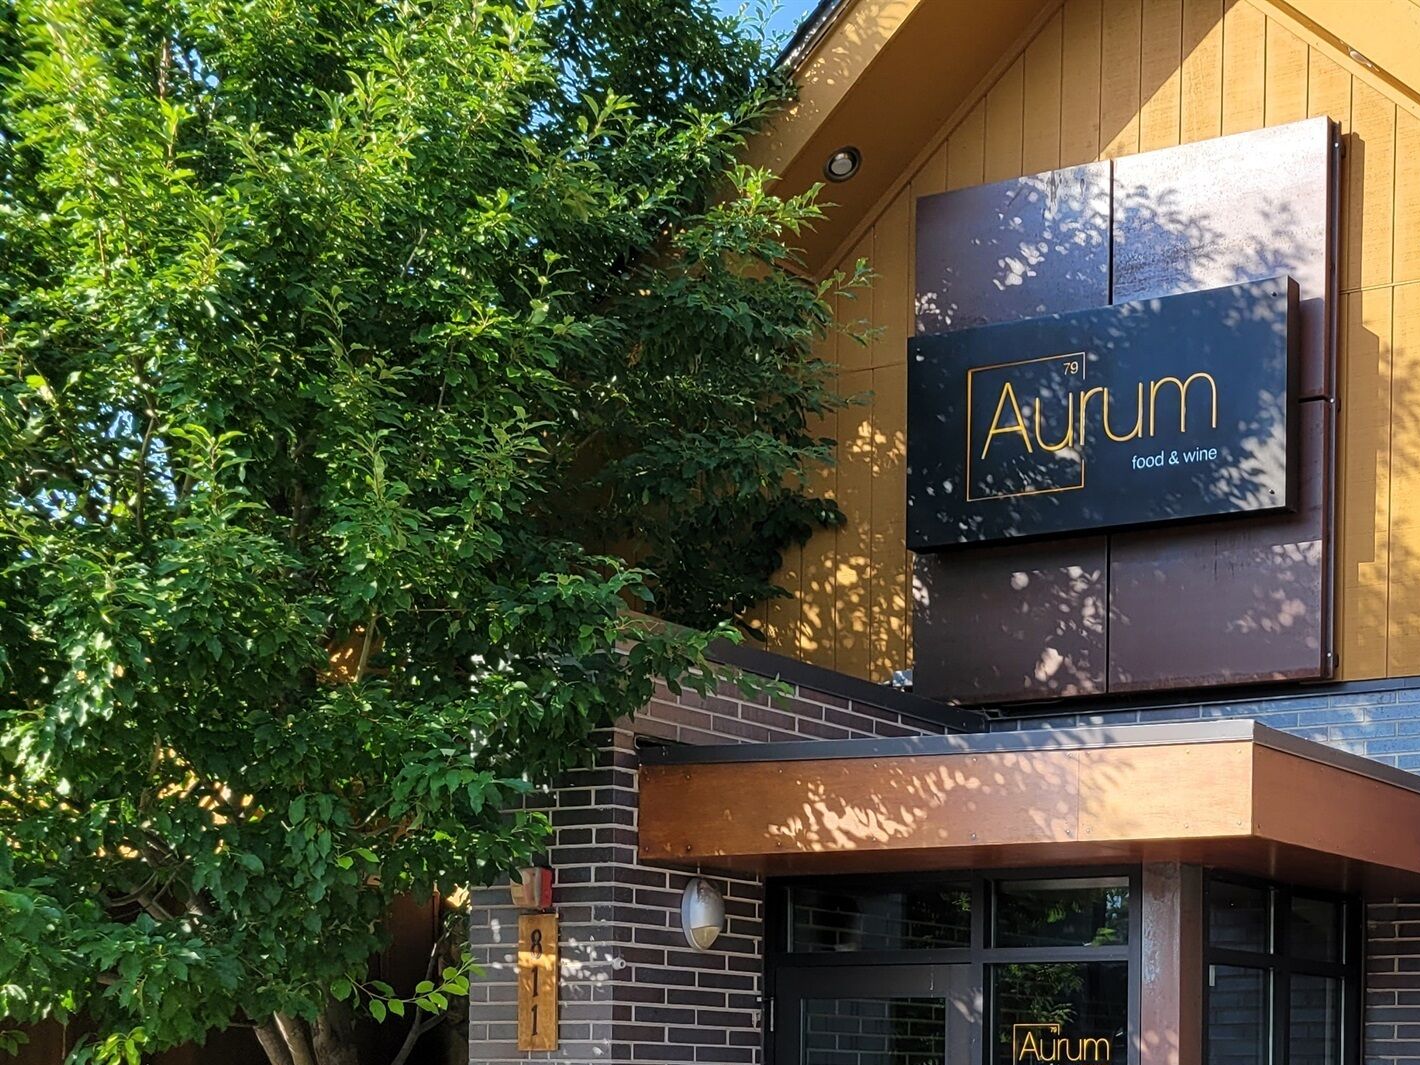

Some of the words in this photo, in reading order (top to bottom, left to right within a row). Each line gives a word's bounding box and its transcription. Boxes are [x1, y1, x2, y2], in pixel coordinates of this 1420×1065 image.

[1063, 361, 1080, 376] 79
[980, 371, 1218, 460] Aurum
[1131, 451, 1165, 469] food
[1168, 449, 1180, 465] &
[1182, 446, 1218, 463] wine
[530, 928, 543, 1036] 811
[1018, 1031, 1110, 1061] Aurum
